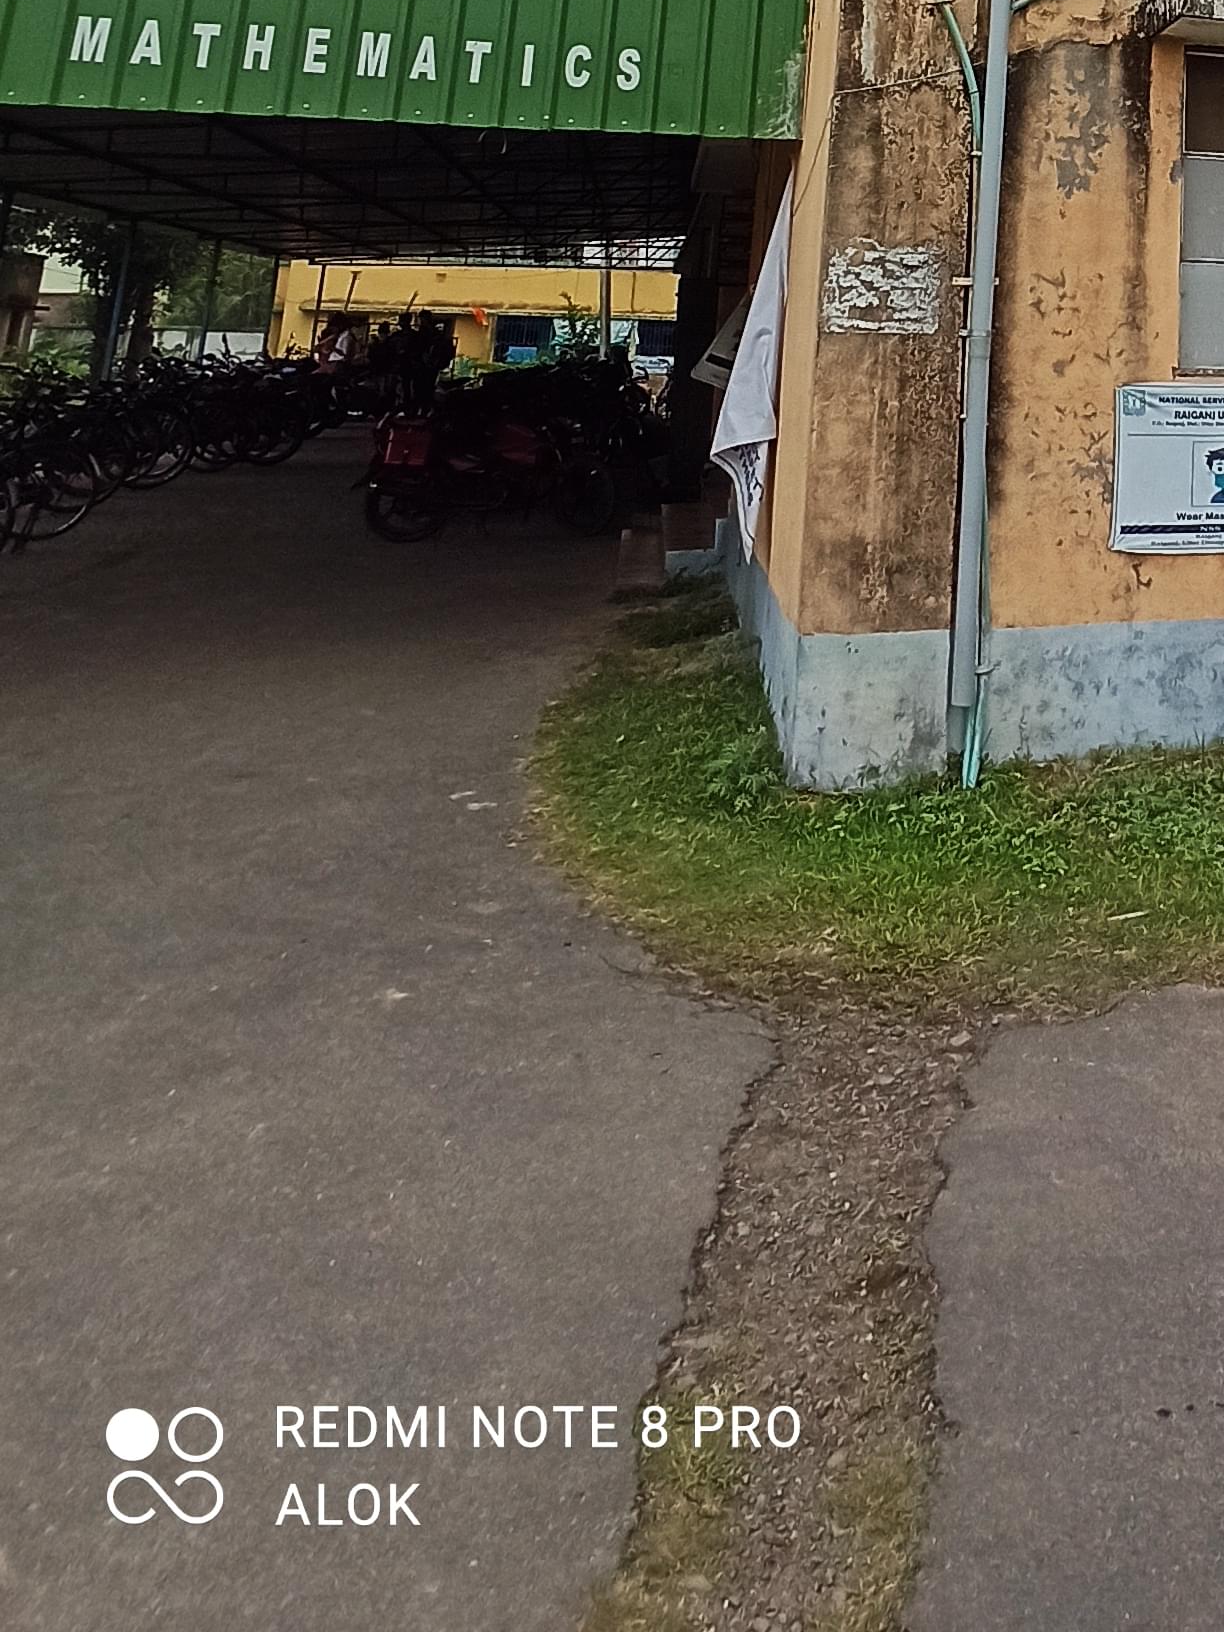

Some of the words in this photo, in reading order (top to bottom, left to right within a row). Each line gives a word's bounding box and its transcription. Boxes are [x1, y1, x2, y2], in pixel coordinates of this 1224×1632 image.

[69, 15, 642, 92] MATHEMATICS
[1158, 396, 1200, 404] NATIONAL
[1174, 410, 1216, 420] RAIGANJ
[1176, 512, 1203, 521] Wear
